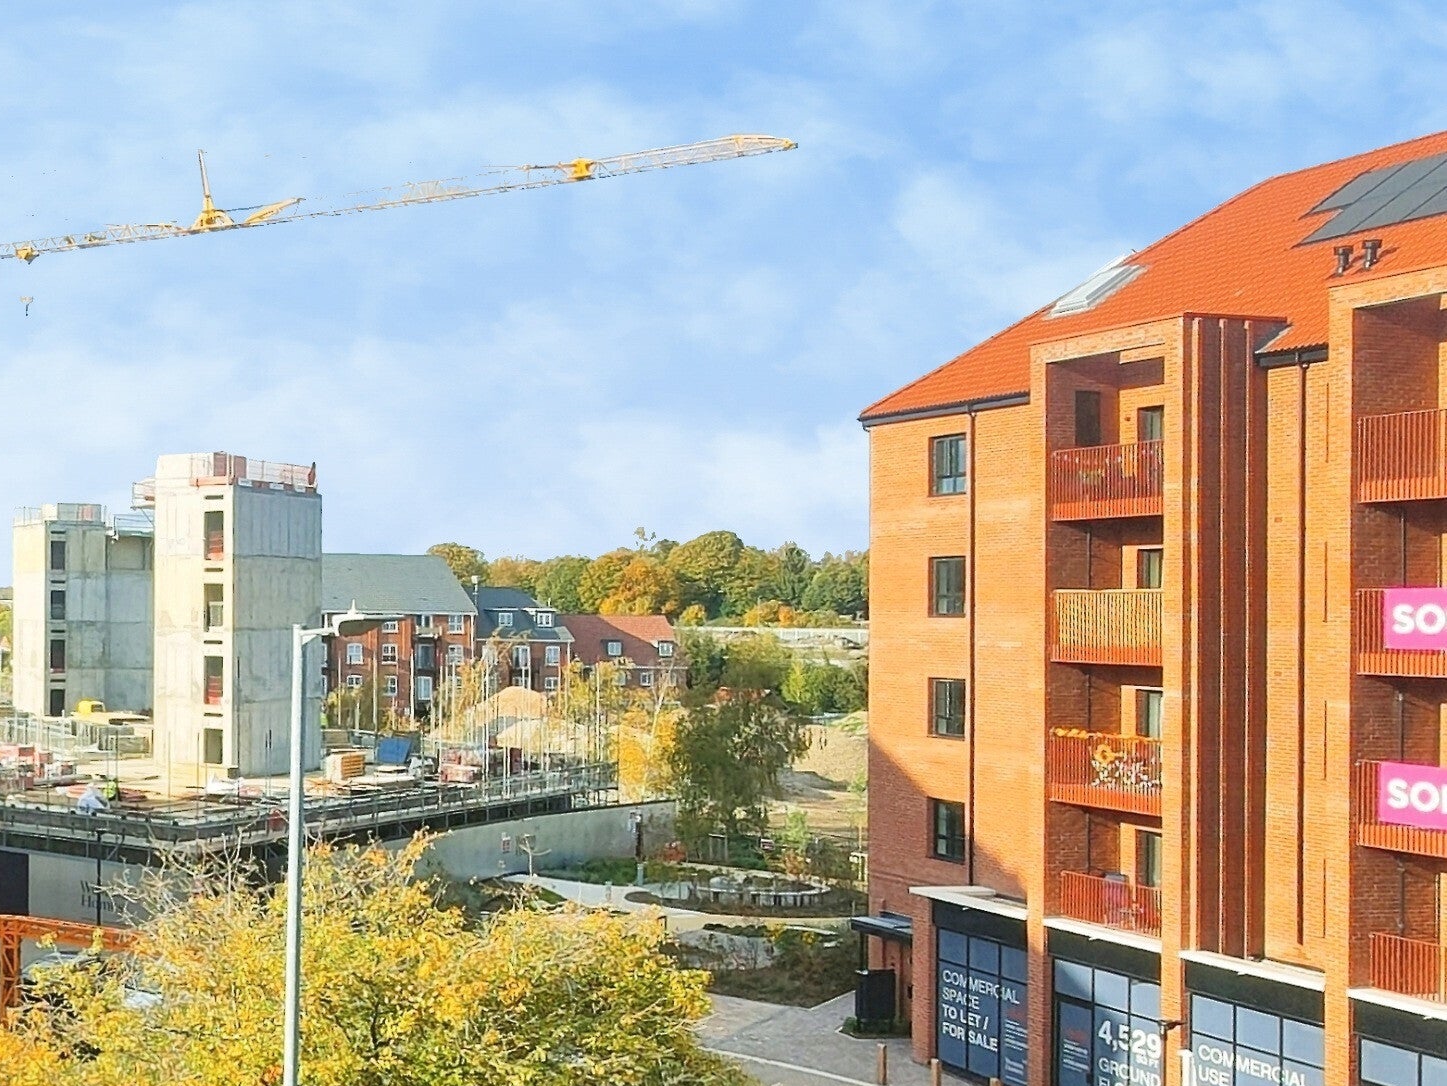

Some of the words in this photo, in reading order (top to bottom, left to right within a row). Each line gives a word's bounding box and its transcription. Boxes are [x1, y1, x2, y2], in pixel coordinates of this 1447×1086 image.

[942, 969, 1021, 1005] COMMERCIAL
[942, 986, 980, 1010] SPACE
[942, 1003, 958, 1020] TO
[959, 1008, 981, 1028] LET
[942, 1021, 965, 1041] FOR
[968, 1029, 998, 1052] SALE
[1098, 1020, 1162, 1060] 4,529
